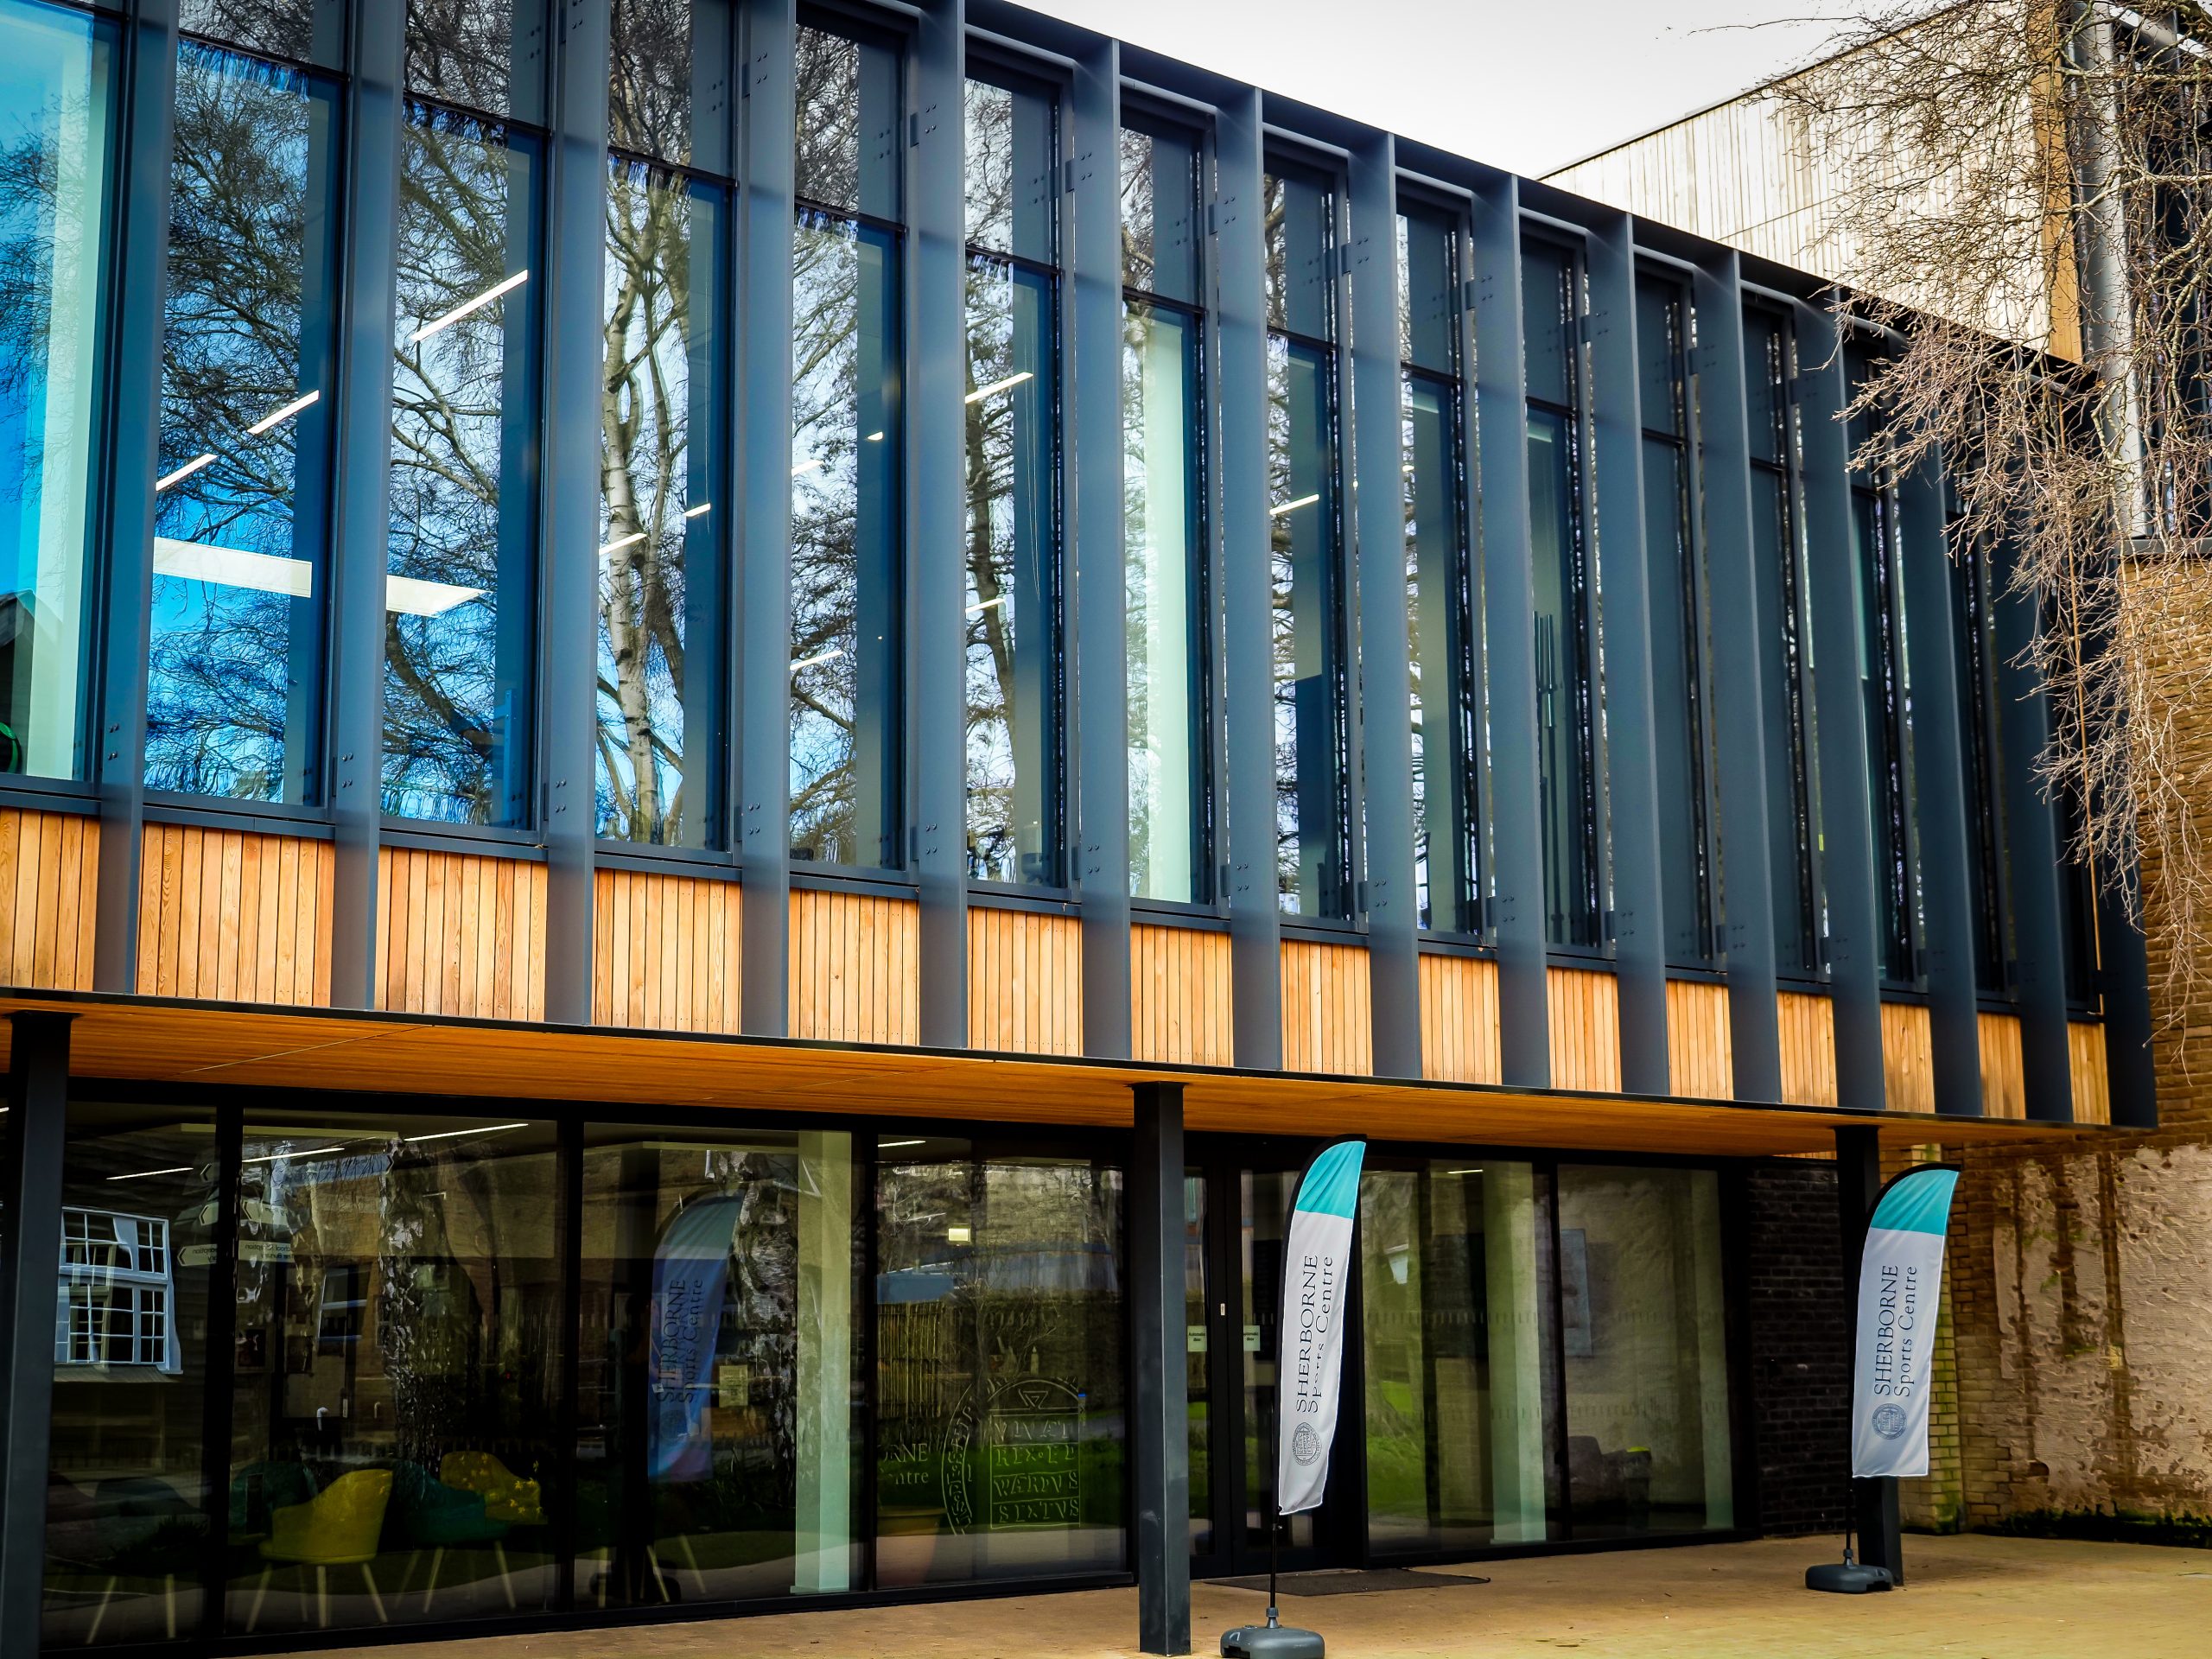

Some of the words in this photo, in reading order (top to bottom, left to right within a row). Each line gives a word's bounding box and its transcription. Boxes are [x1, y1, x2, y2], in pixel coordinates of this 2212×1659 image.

[682, 1279, 703, 1341] Centre
[1315, 1255, 1333, 1333] Centre
[1897, 1266, 1917, 1331] Centre
[655, 1279, 686, 1403] SHERBORNE
[1296, 1255, 1318, 1414] SHERBORNE
[1874, 1265, 1898, 1395] SHERBORNE
[677, 1347, 697, 1404] Sports
[1307, 1343, 1325, 1414] Sports
[1893, 1338, 1915, 1397] Sports
